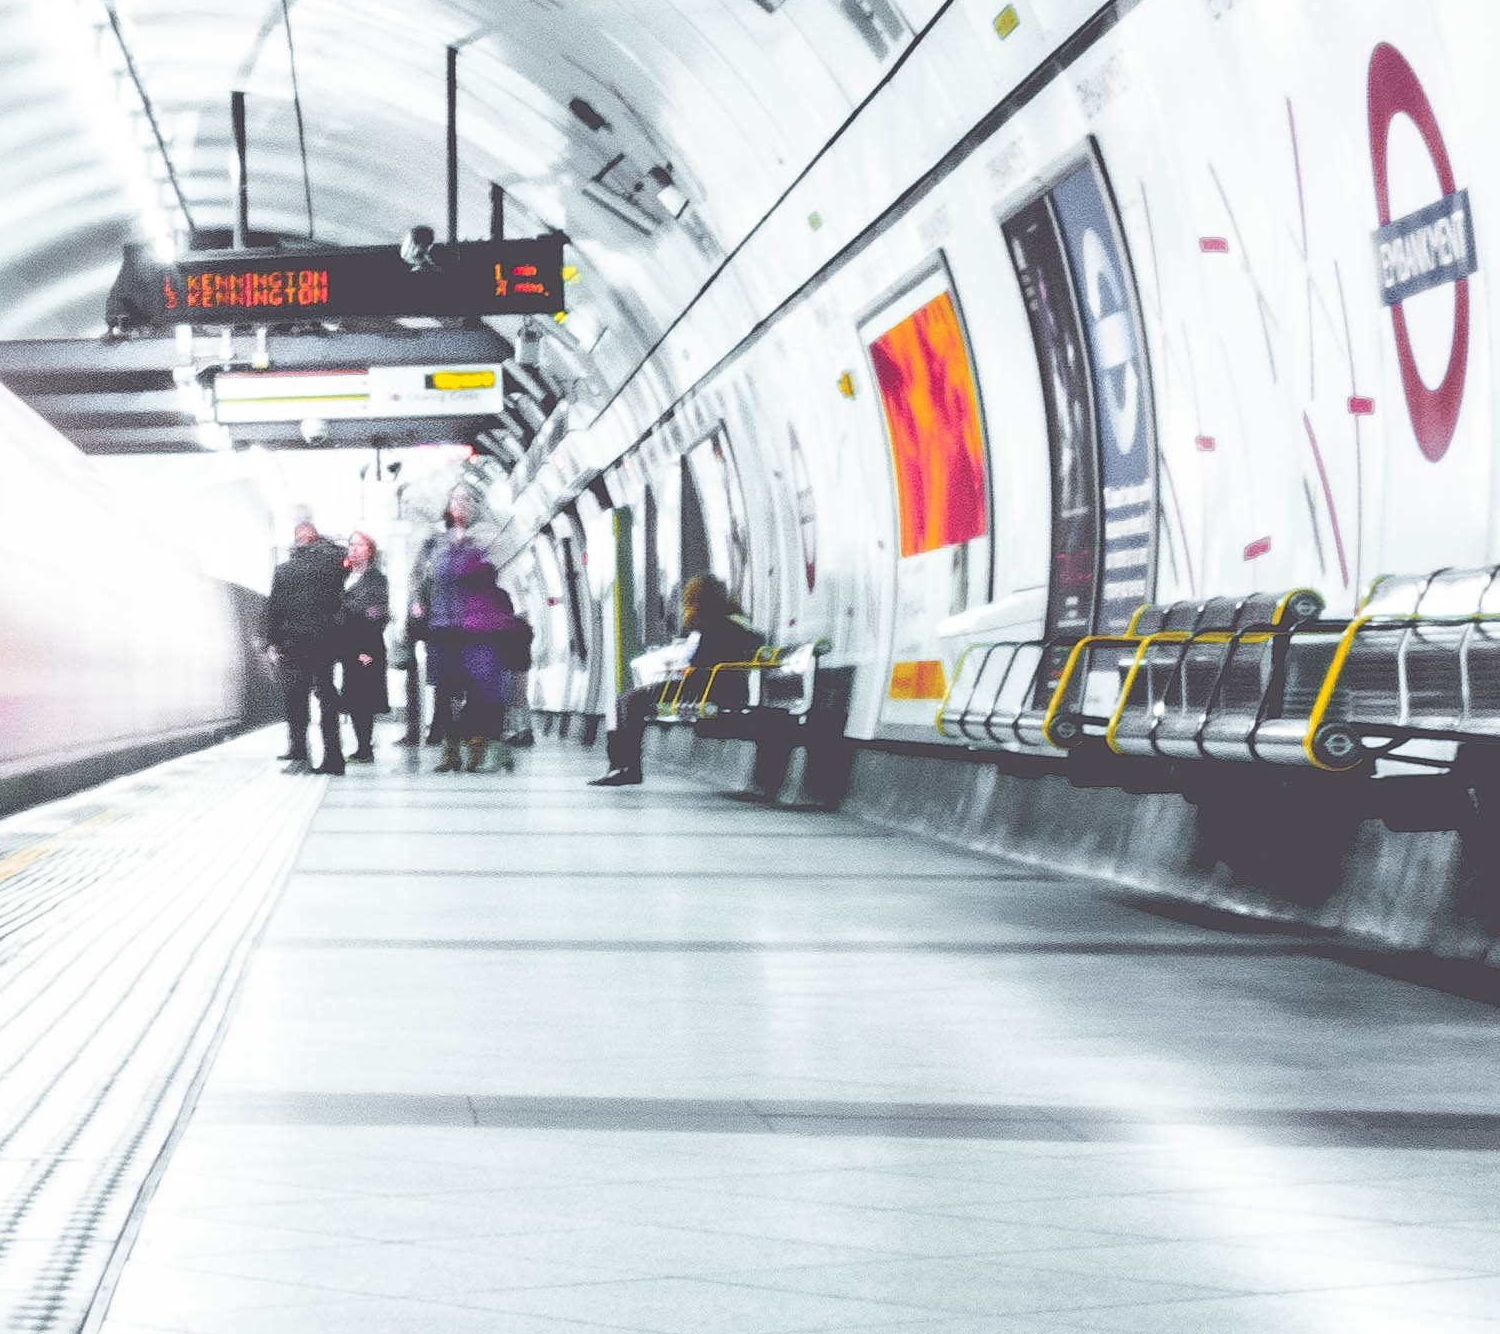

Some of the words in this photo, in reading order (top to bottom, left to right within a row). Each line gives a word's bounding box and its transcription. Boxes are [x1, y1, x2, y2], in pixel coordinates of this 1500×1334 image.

[1379, 210, 1468, 287] EMBANKMENT
[187, 270, 328, 290] KENNINGTON
[187, 288, 328, 307] KENNINGTON
